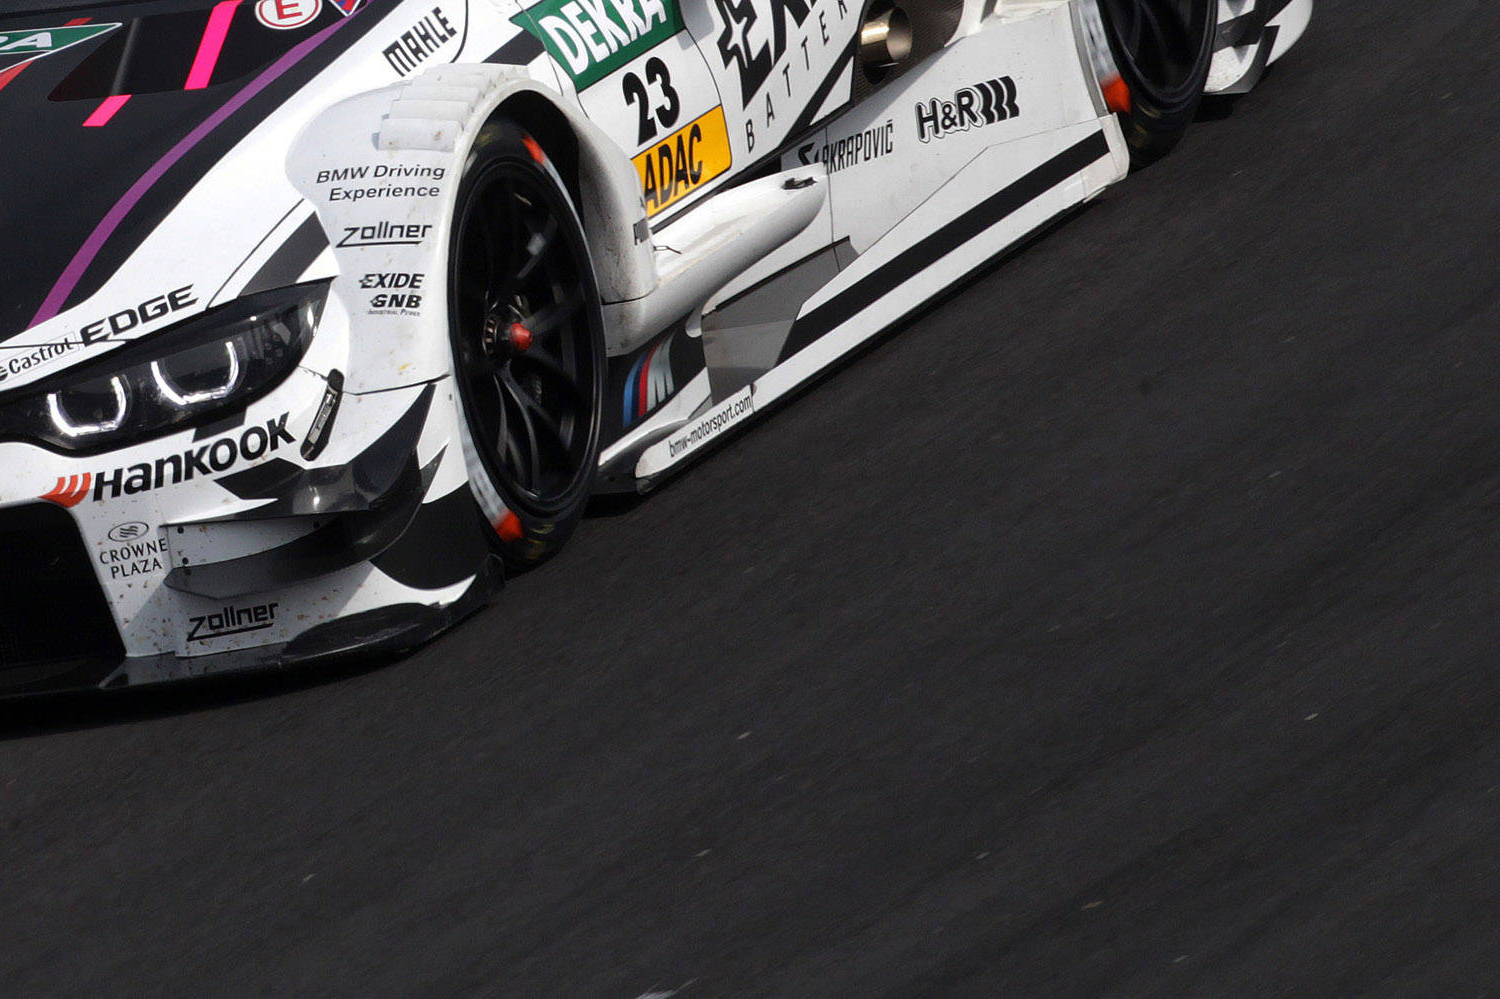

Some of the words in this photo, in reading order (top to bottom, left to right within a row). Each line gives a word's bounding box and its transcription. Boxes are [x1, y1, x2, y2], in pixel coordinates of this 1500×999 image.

[382, 6, 458, 77] MAHLE
[622, 56, 681, 146] 23
[915, 88, 984, 143] H&R
[316, 165, 370, 184] BMW
[374, 164, 446, 180] Driving
[644, 123, 703, 209] ADAC
[329, 184, 440, 202] Experience
[359, 273, 425, 289] EXIDE
[370, 293, 422, 308] GNB
[8, 337, 75, 375] Castrol
[80, 283, 199, 347] EDGE
[668, 396, 753, 458] bmw-motorsport.com
[100, 537, 168, 565] CROWNE
[111, 557, 162, 579] PLAZA
